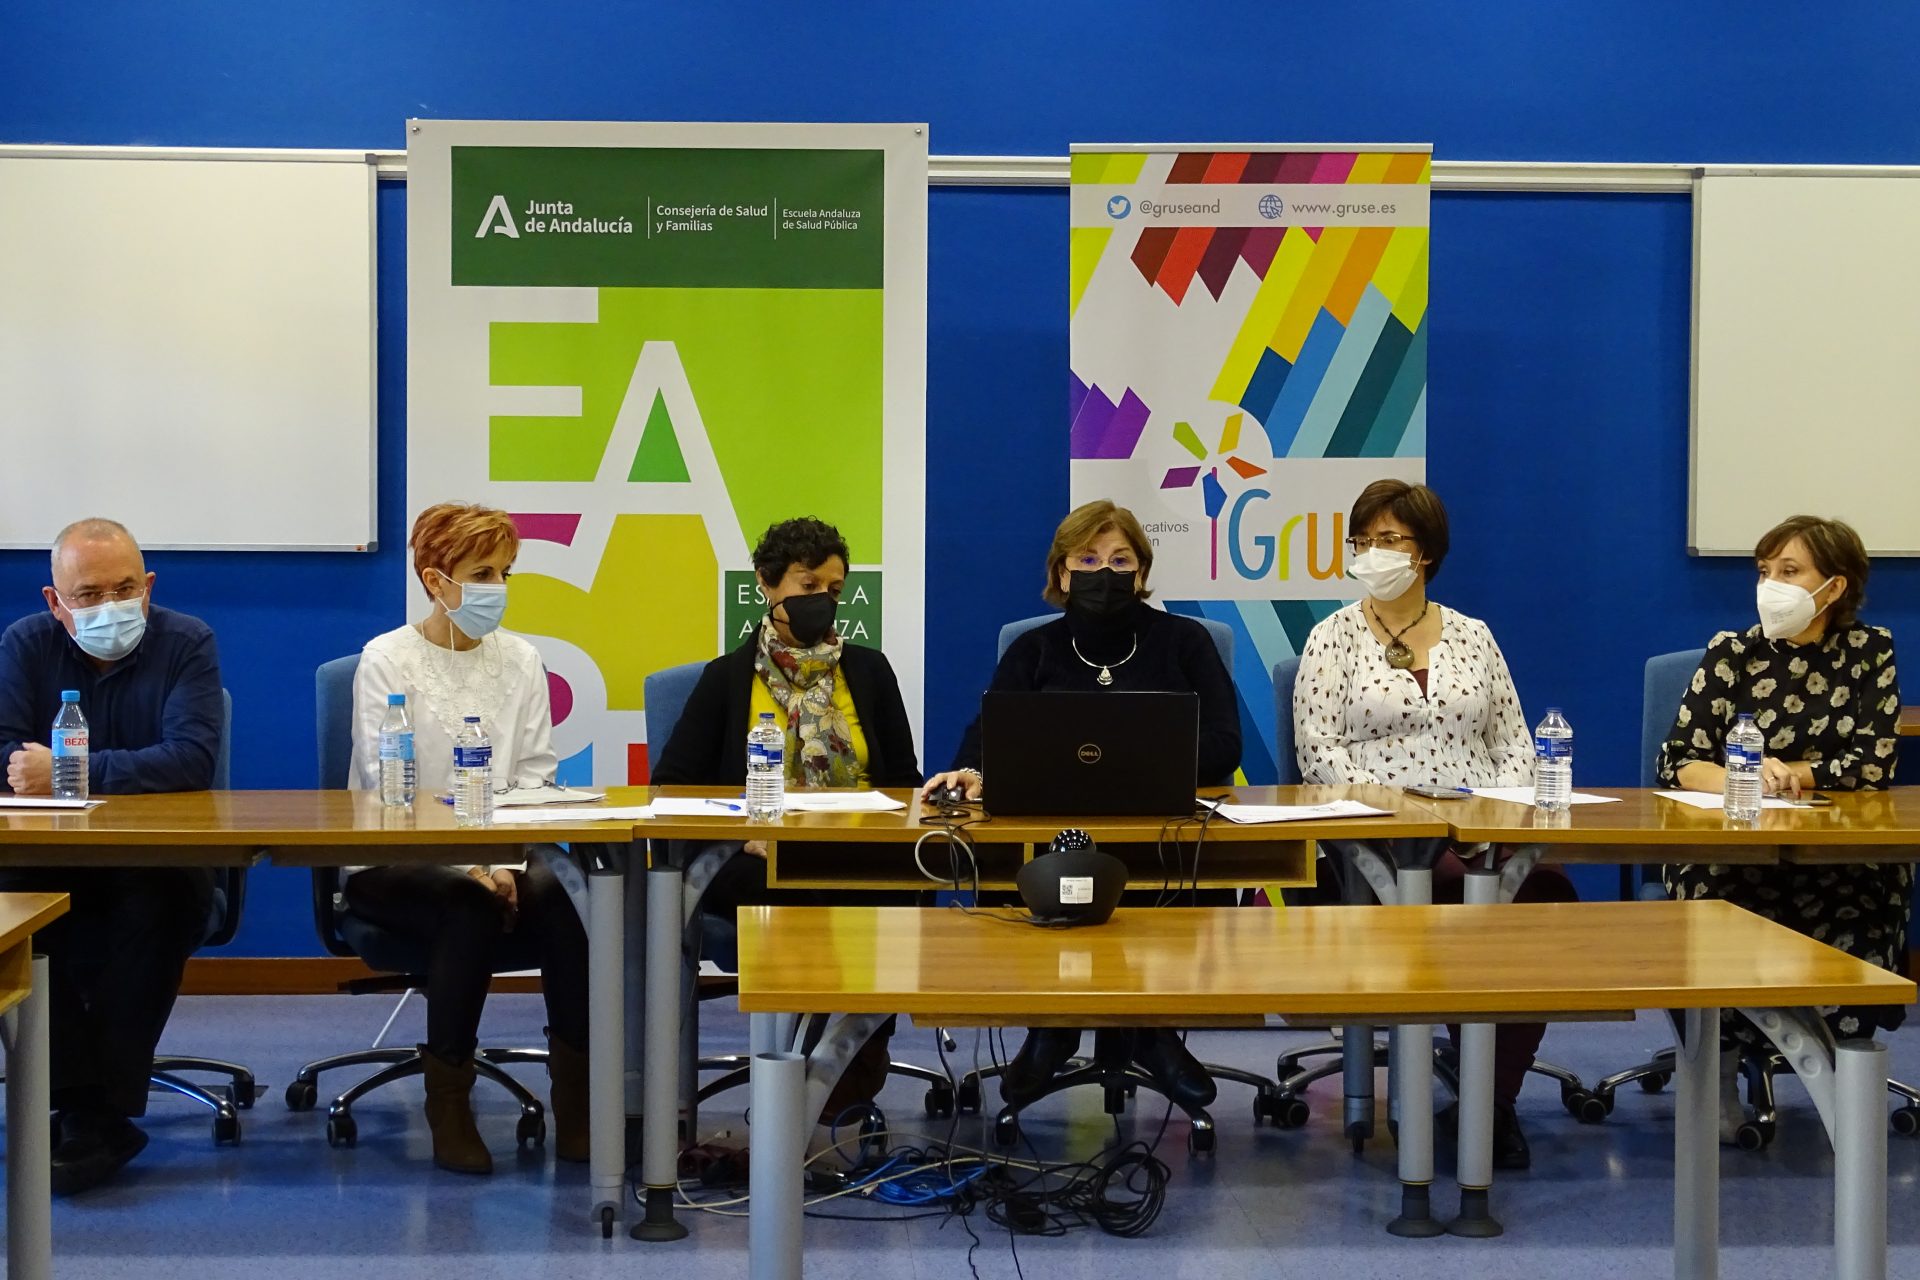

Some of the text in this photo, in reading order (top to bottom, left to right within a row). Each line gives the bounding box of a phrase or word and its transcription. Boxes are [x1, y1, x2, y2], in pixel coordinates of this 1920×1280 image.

[525, 199, 574, 216] Junta
[656, 204, 768, 219] Consejería de Salud
[782, 208, 861, 219] Escuela Andaluza
[1139, 198, 1221, 219] @gruseand
[1291, 203, 1397, 219] www.gruse.es
[524, 214, 633, 234] de Andalucía
[656, 219, 713, 234] y Familias
[782, 219, 858, 230] de Salud Pública
[1228, 489, 1358, 581] Gru
